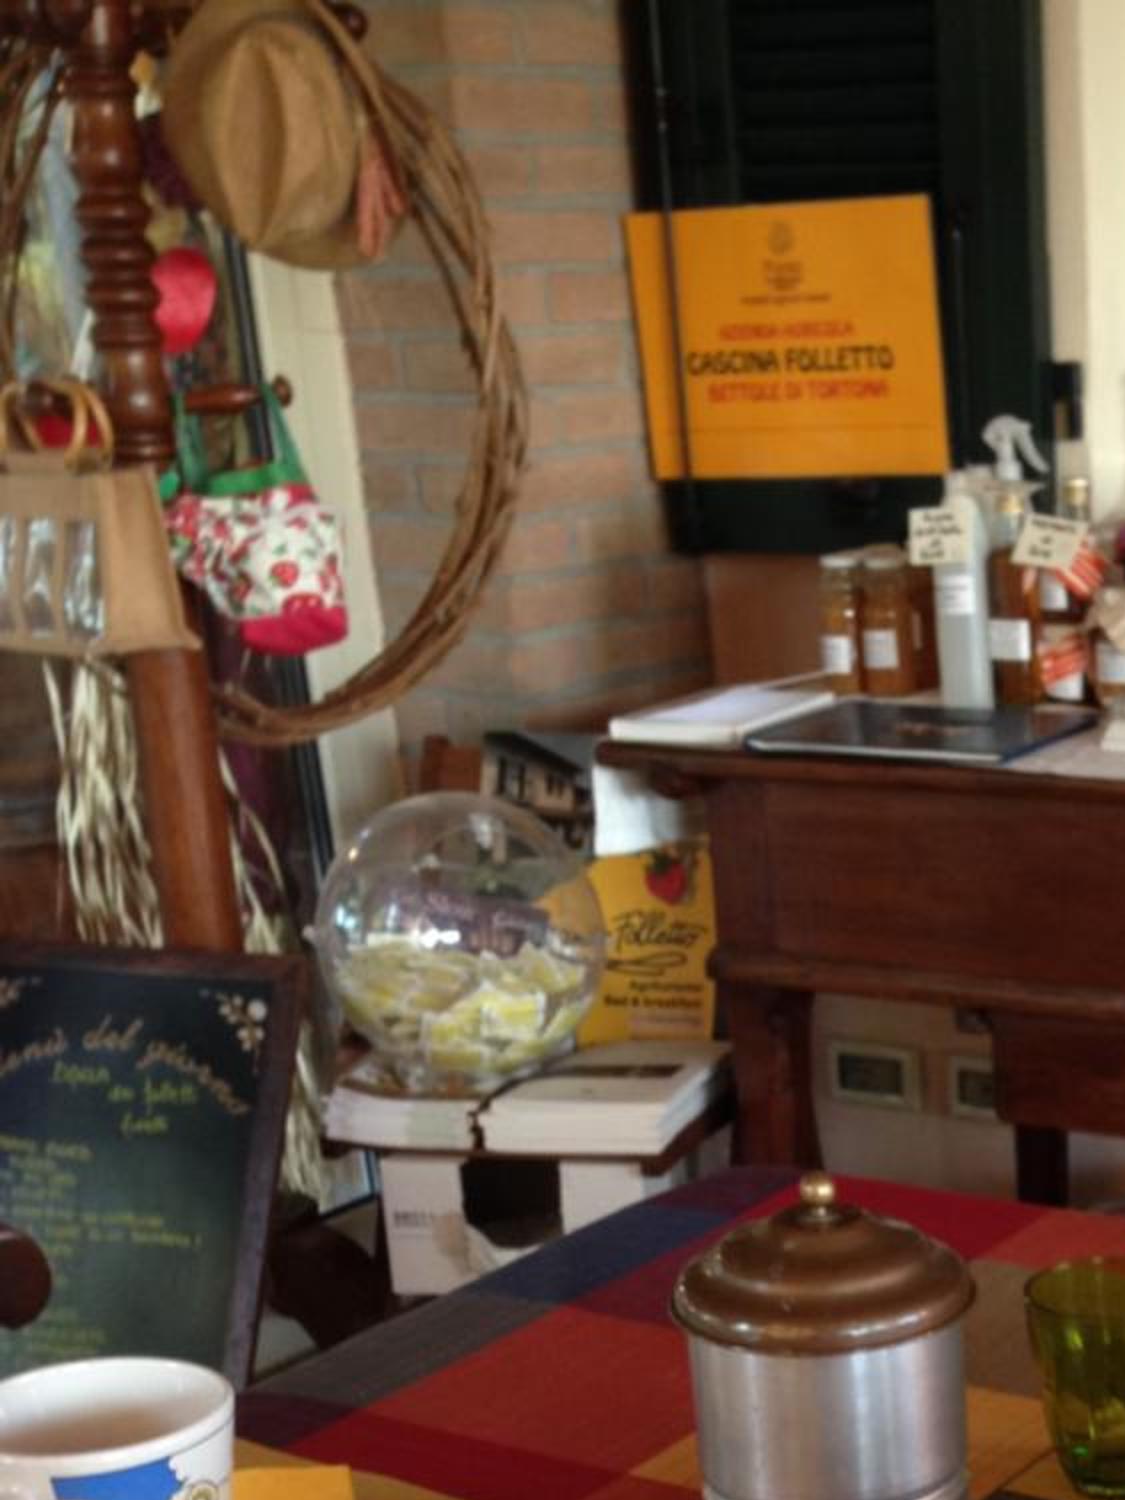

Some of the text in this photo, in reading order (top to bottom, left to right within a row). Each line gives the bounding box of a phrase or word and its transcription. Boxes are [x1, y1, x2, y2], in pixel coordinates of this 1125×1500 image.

[688, 344, 894, 376] CASCINA FOLLETTO
[785, 380, 802, 399] DI
[808, 378, 889, 398] TORTONA
